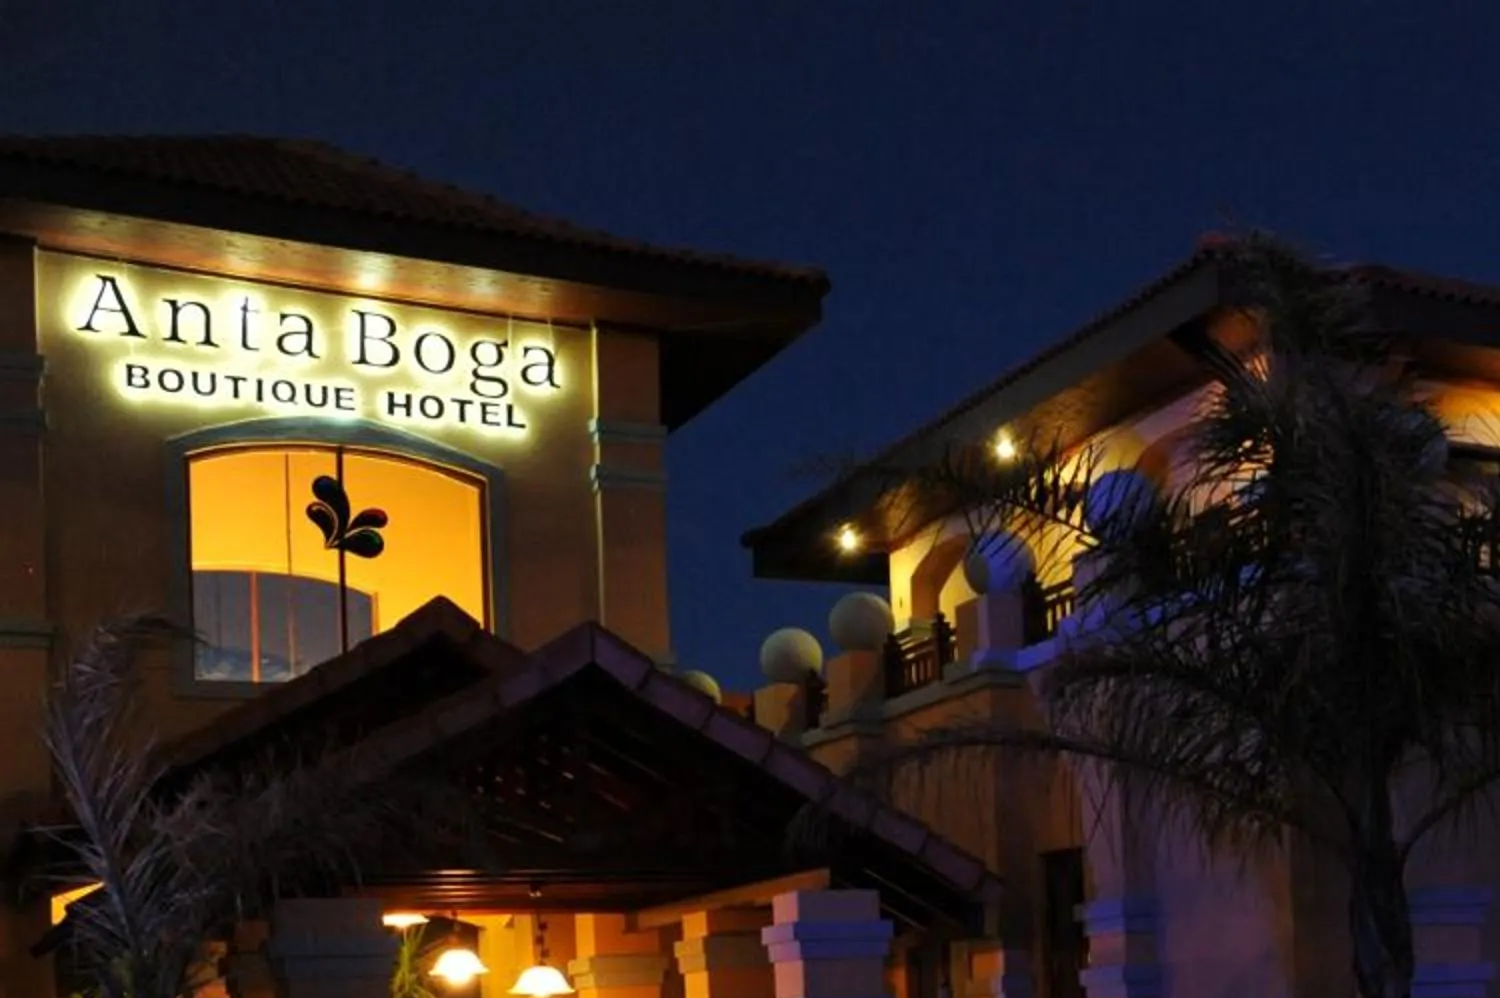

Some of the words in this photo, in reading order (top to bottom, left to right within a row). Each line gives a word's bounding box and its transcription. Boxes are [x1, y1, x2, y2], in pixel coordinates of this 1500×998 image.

[77, 274, 319, 358] Anta
[352, 309, 561, 398] Boga
[125, 364, 355, 410] BOUTIQUE
[386, 391, 527, 428] HOTEL
